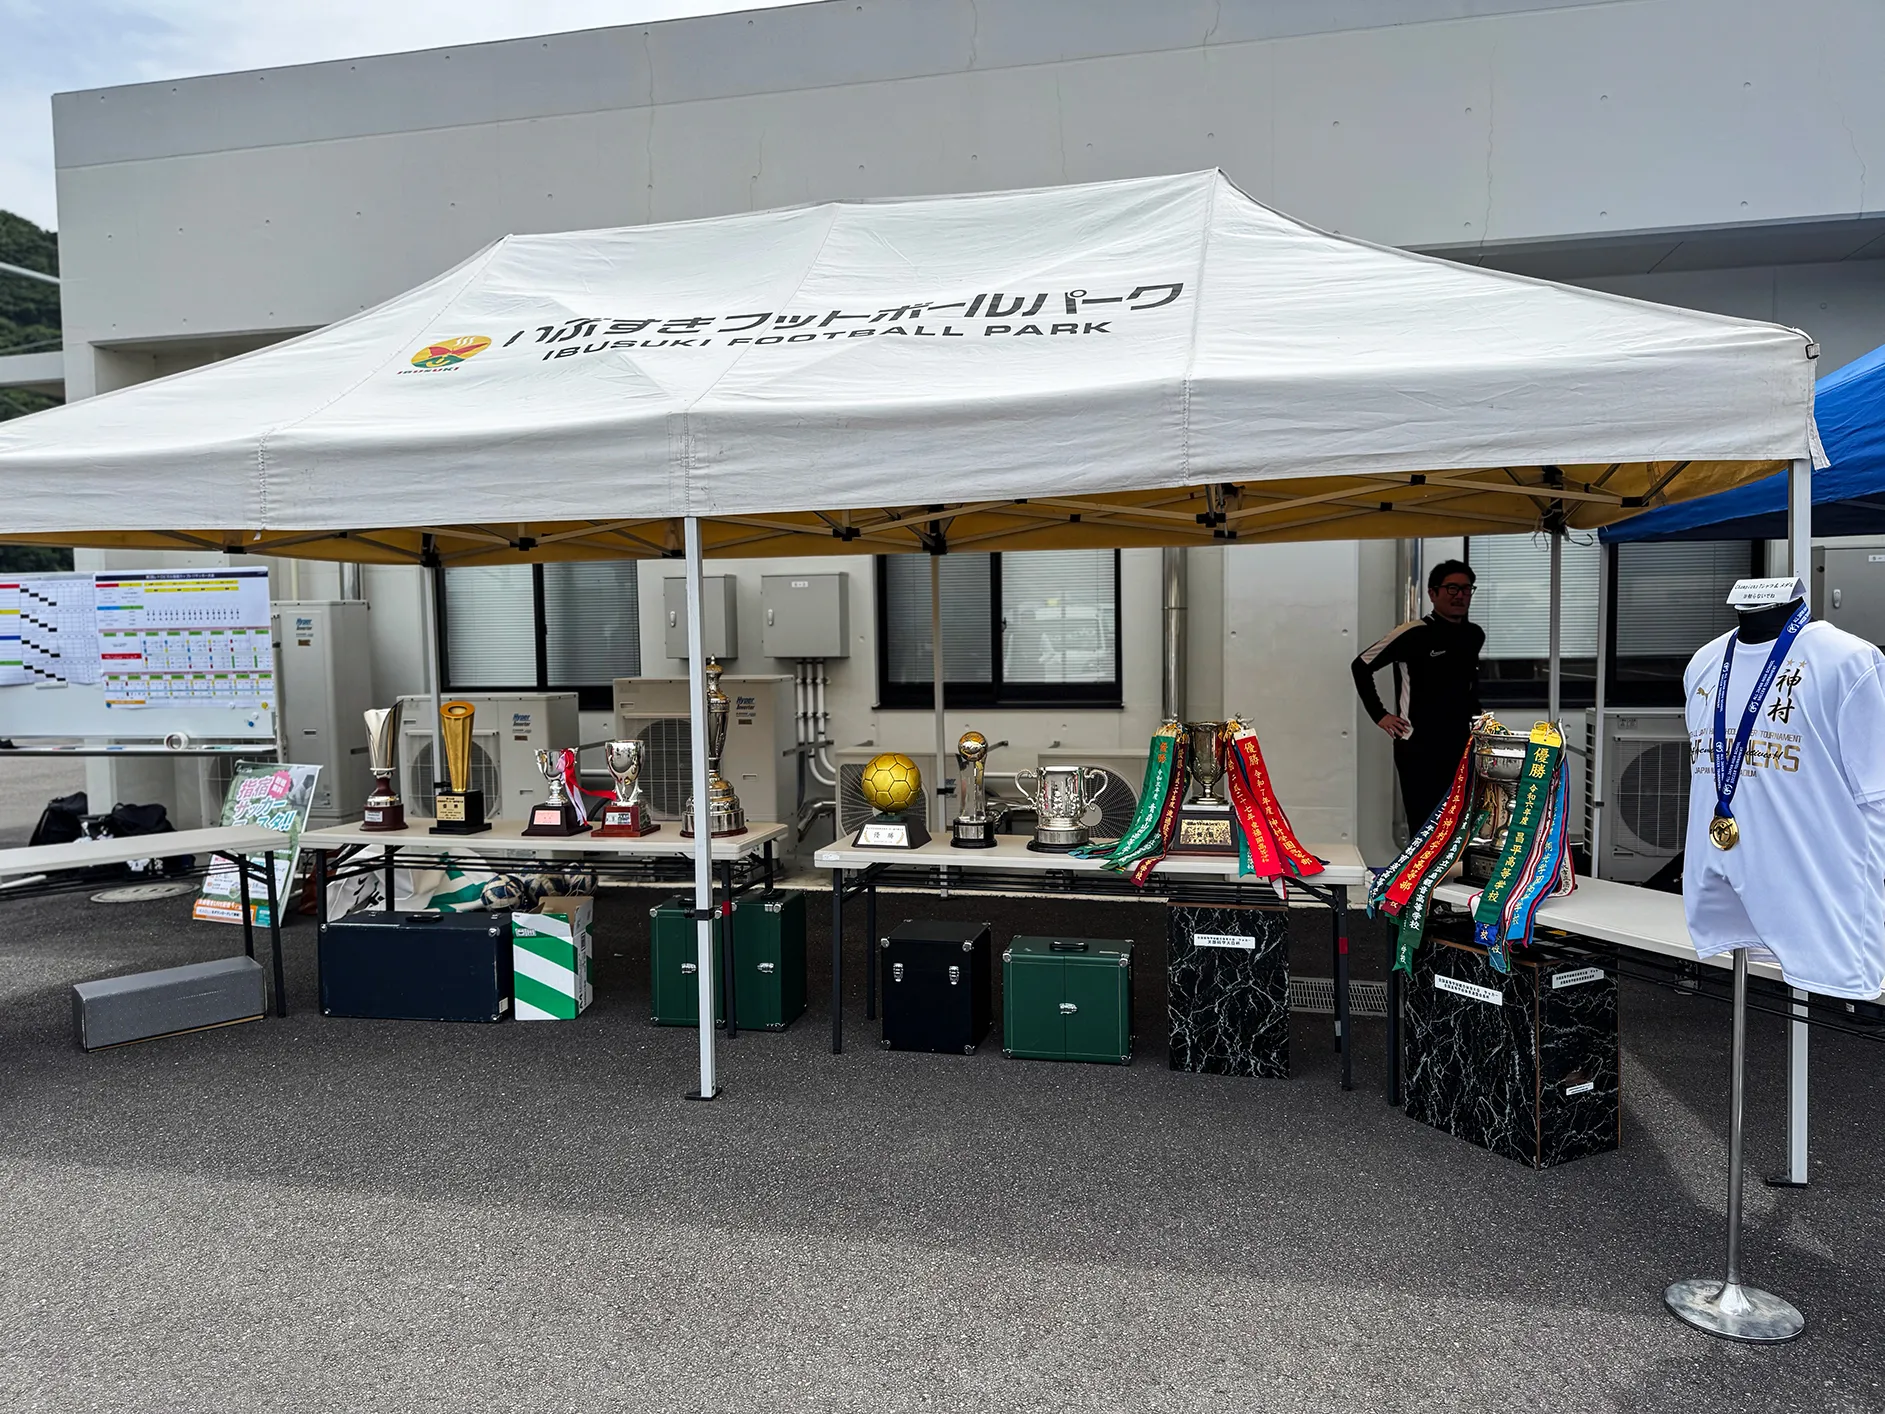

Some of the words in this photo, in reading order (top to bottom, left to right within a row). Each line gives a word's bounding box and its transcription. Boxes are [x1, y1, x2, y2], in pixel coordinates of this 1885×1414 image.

[503, 283, 1184, 347] いぶすきフットボールパーク
[542, 339, 712, 361] IBUSUKI
[728, 326, 964, 347] FOOTBALL
[984, 321, 1112, 336] PARK
[397, 366, 460, 375] IBUSUKI
[1755, 681, 1763, 693] JAPAN
[1760, 672, 1768, 682] HIGH
[1765, 658, 1775, 673] SCHOOL
[1763, 664, 1777, 687] TOURNAMENT
[1767, 668, 1801, 724] 神村
[1760, 730, 1802, 743] TOURNAMENT
[1244, 741, 1259, 766] 優勝
[1529, 748, 1550, 779] 優勝
[237, 775, 274, 801] 指宿
[232, 810, 298, 831] スタ!!
[233, 796, 287, 820] サッカー
[1519, 784, 1538, 826] 令和六年度
[1399, 818, 1453, 891] 神村学園高等部
[1488, 832, 1525, 902] 昌平高等学校
